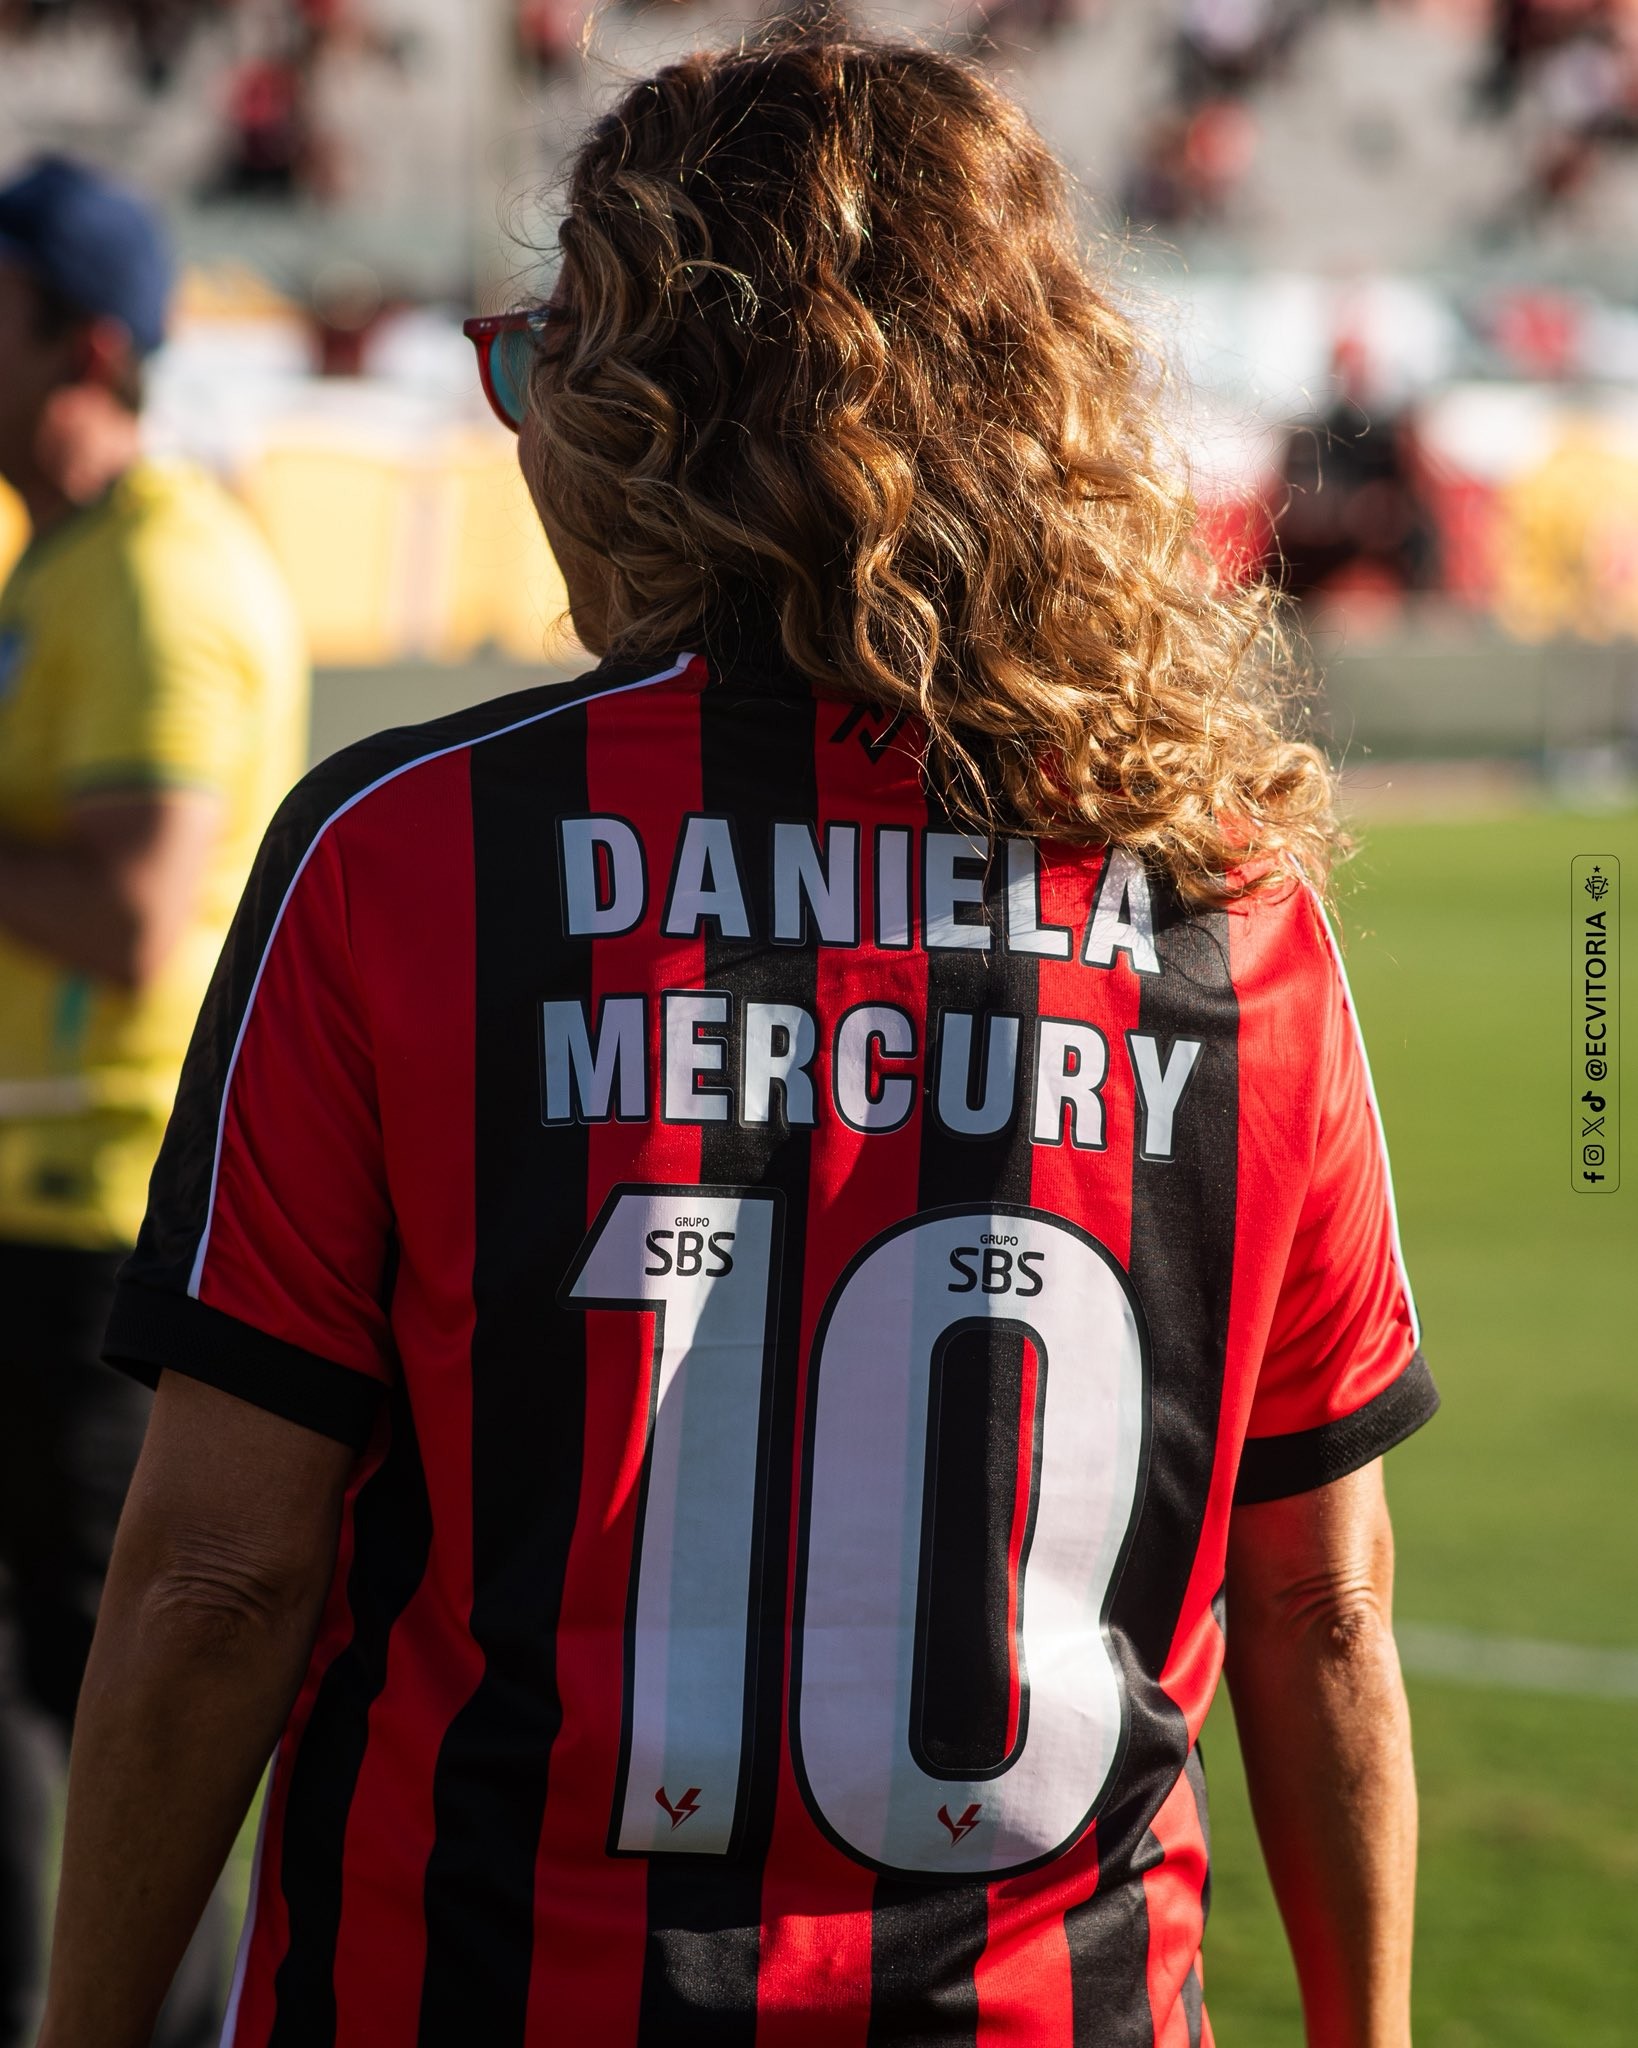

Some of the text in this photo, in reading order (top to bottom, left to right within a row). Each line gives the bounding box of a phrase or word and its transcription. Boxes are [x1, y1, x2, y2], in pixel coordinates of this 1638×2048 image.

[558, 815, 1163, 976] DANIELA
[541, 992, 1202, 1160] MERCURY
[674, 1216, 710, 1228] GRUPO
[979, 1233, 1019, 1247] GRUPO
[645, 1230, 736, 1277] SBS
[947, 1246, 1045, 1297] SBS
[566, 1190, 1148, 1875] 10
